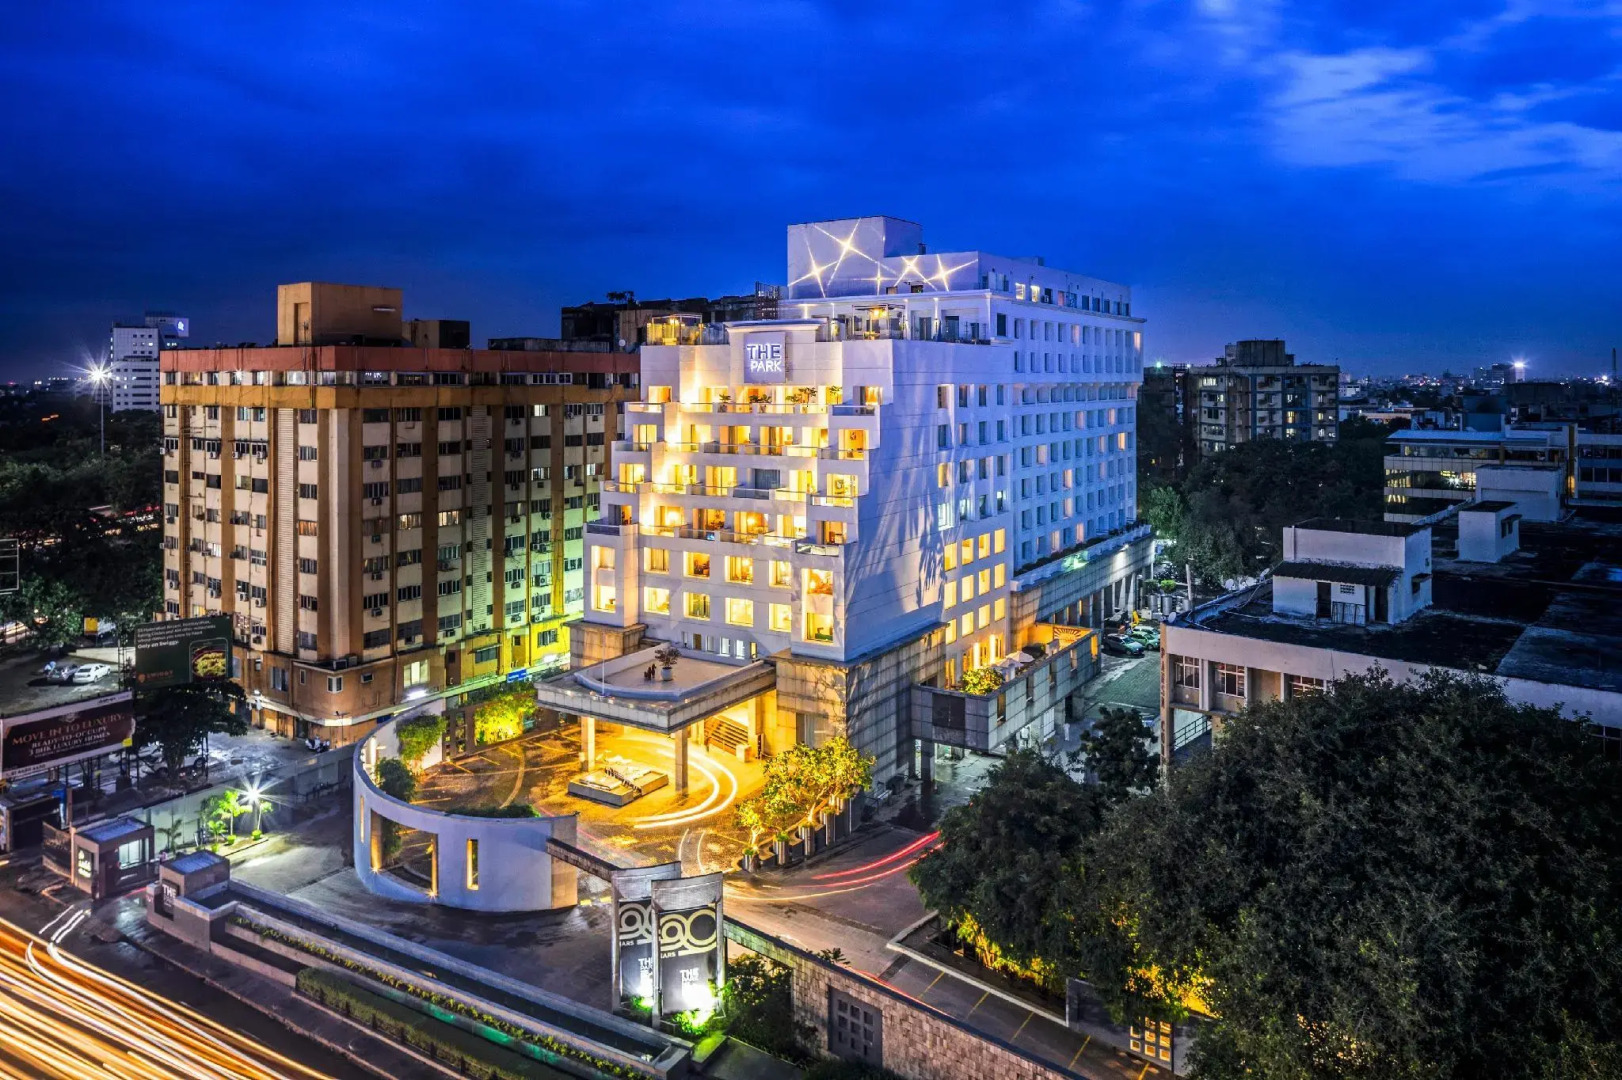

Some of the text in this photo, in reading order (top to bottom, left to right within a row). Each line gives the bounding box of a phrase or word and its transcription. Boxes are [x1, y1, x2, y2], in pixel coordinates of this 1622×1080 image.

[746, 343, 782, 360] THE
[750, 359, 783, 373] PARK
[12, 731, 47, 745] MOVE
[49, 727, 62, 737] IN
[65, 724, 80, 733] TO
[53, 739, 83, 751] LUXURY
[84, 732, 111, 743] HOMES
[162, 884, 176, 899] THE
[680, 967, 699, 979] THE
